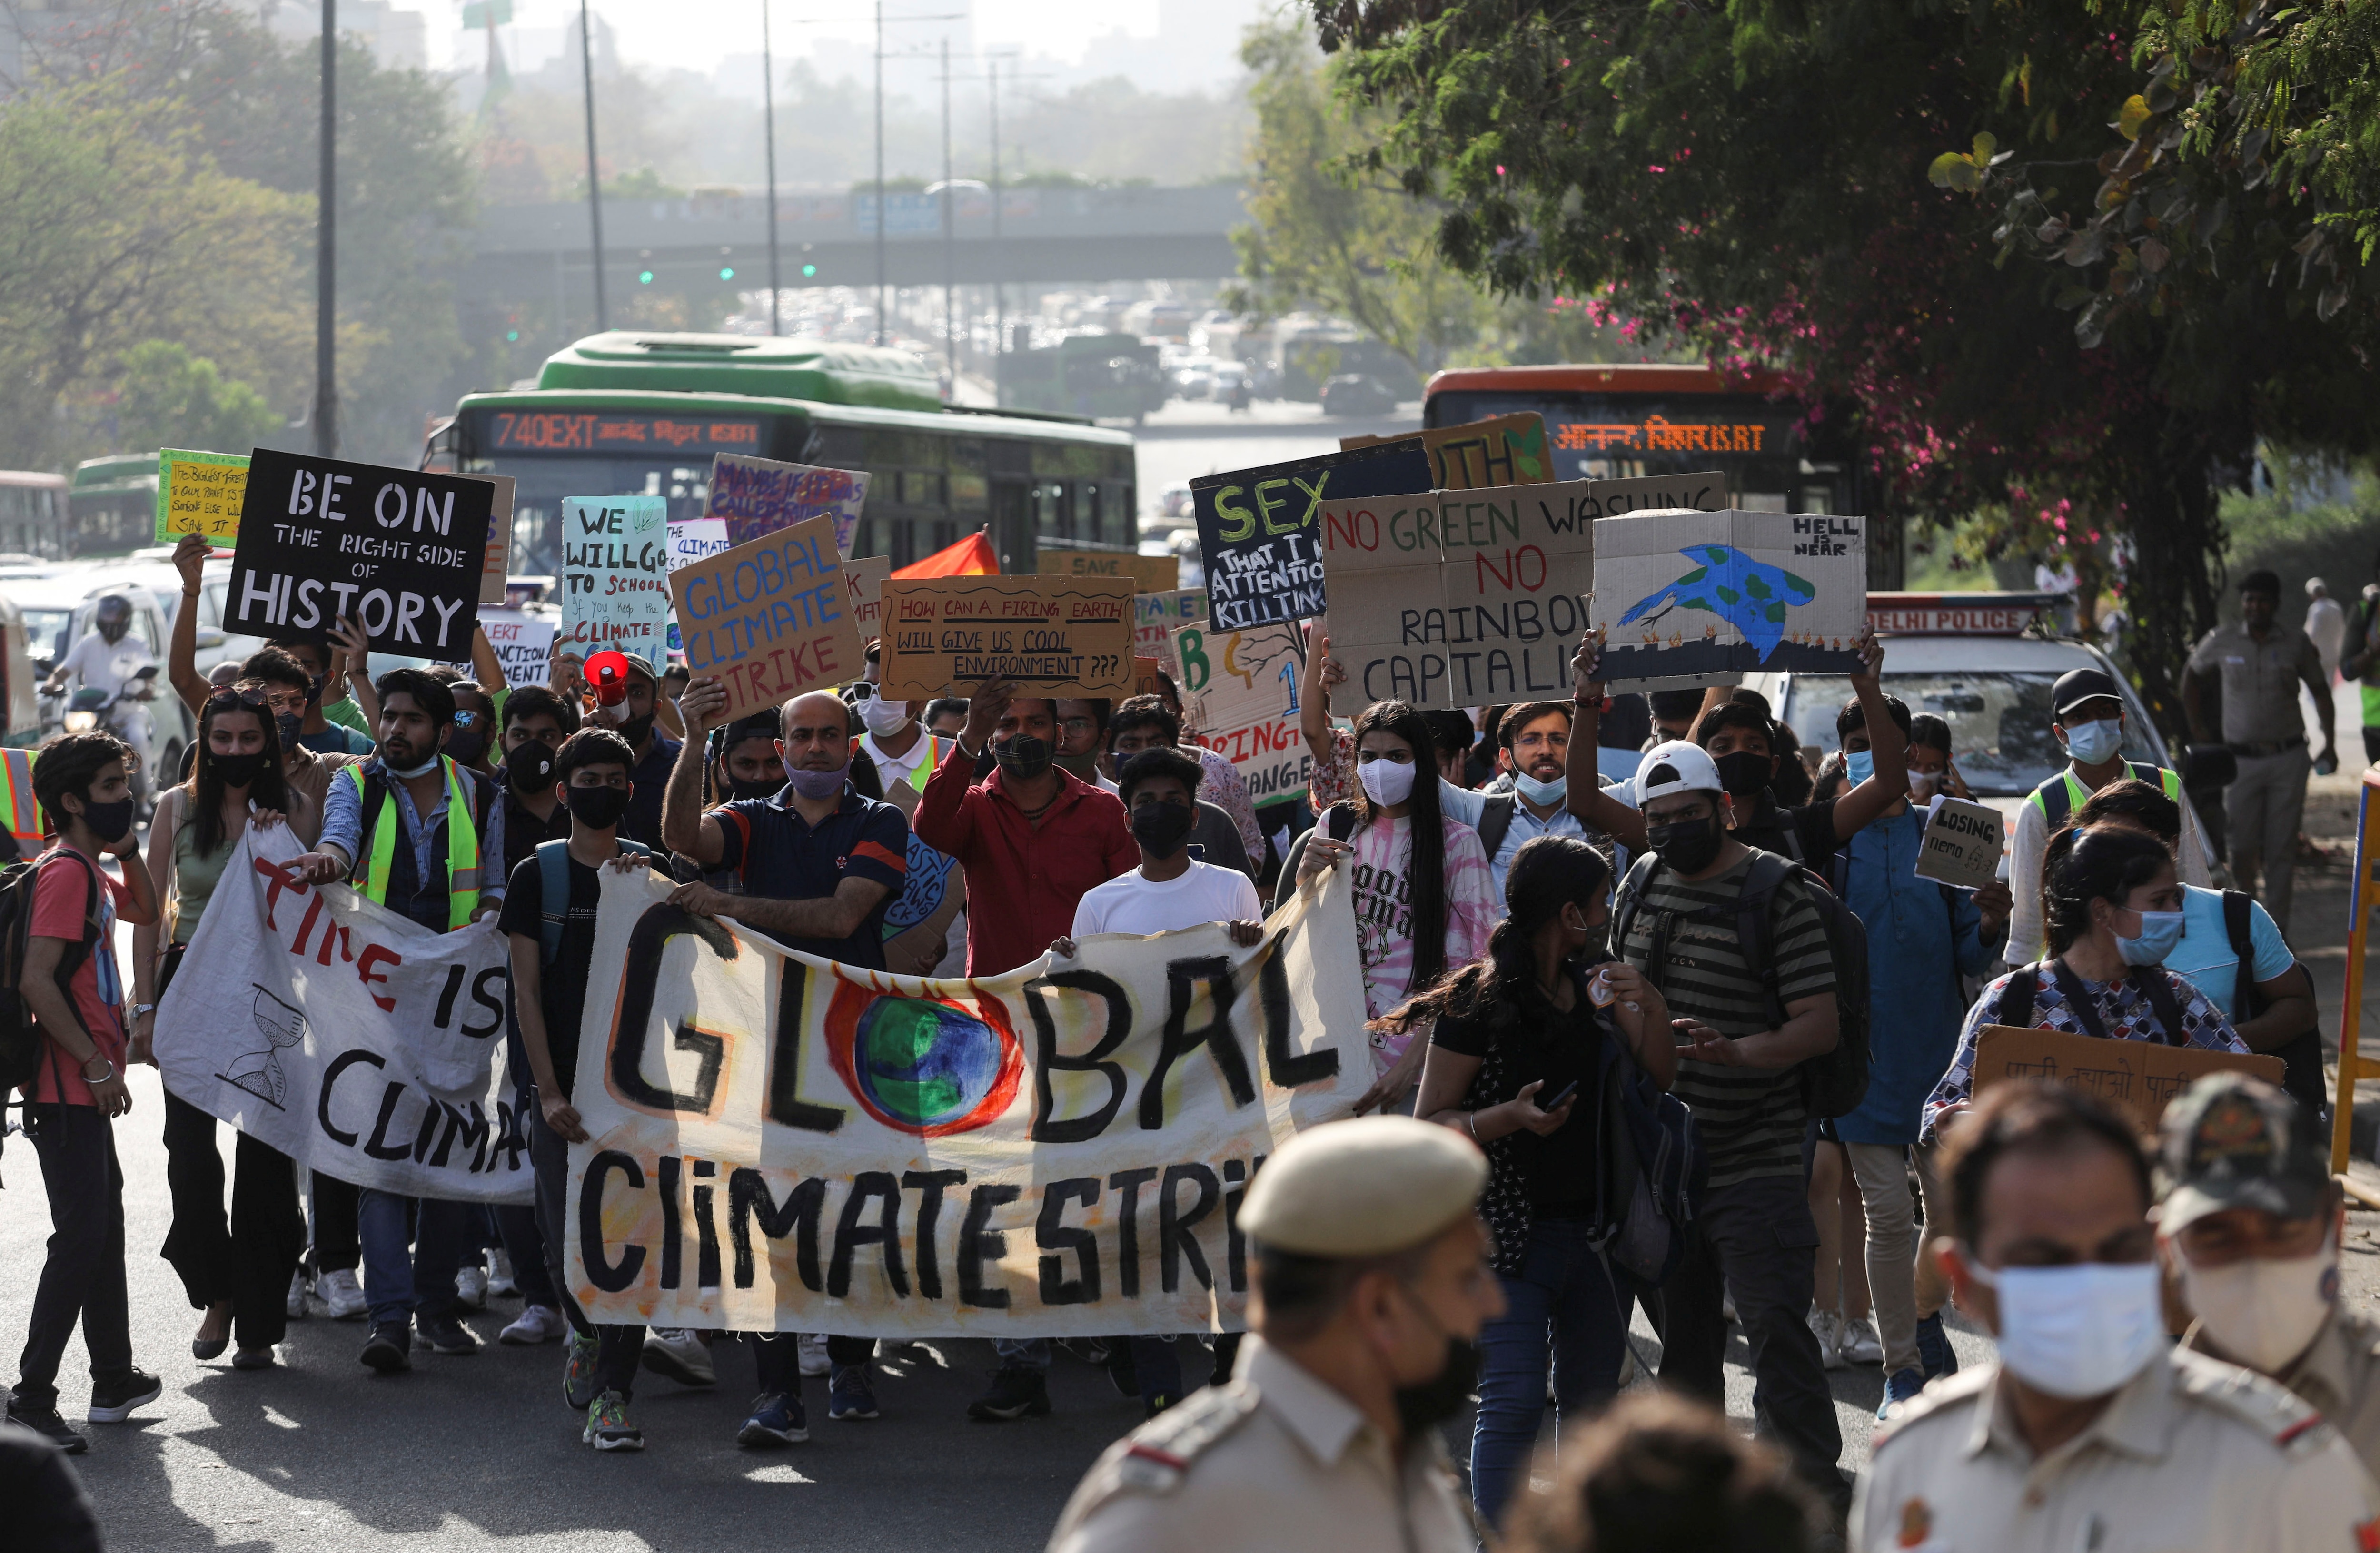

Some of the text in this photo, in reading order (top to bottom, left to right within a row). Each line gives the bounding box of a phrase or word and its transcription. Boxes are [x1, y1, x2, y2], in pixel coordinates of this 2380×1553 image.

[497, 413, 599, 449] 740EXT
[227, 489, 237, 500] IS
[714, 460, 783, 496] MAYBE
[830, 483, 863, 502] WAS
[205, 503, 222, 514] ELSE
[228, 504, 241, 516] WIL
[288, 469, 352, 521] BE
[375, 483, 455, 536] ON
[1214, 470, 1330, 542] SEX
[176, 517, 229, 533] SAVE IT
[579, 507, 625, 535] WE
[1326, 510, 1379, 552] NO
[1389, 499, 1521, 552] GREEN
[1793, 518, 1859, 535] HELL
[274, 524, 322, 548] THE
[340, 534, 411, 560] RIGHT
[416, 544, 466, 568] SIDE
[678, 539, 730, 556] CLIMATE
[1216, 543, 1275, 573] THAT
[1283, 533, 1309, 567] I
[1794, 543, 1847, 556] NEAR
[1813, 534, 1831, 544] IS
[352, 562, 379, 579] OF
[685, 536, 838, 619] GLOBAL
[1073, 557, 1119, 575] SAVE
[1212, 559, 1324, 600] ATTENTIO
[1476, 544, 1547, 594] NO
[567, 574, 664, 595] TO SCHOOL
[238, 569, 464, 647] HISTORY
[901, 599, 1122, 618] HOW CAN A FIRING EARTH
[1135, 596, 1208, 624] PLANET
[1937, 611, 2019, 630] POLICE
[484, 623, 523, 640] LERT
[575, 620, 651, 643] CLIMATE
[687, 581, 841, 670] CLIMATE
[897, 632, 934, 648] WILL
[942, 631, 983, 650] GIVE
[993, 631, 1012, 650] US
[1024, 630, 1071, 651] COOL
[1135, 624, 1167, 643] RTH
[493, 644, 546, 662] NCTION
[954, 655, 1119, 677] ENVIRONMENT ???
[712, 636, 838, 719] STRIKE
[1364, 644, 1575, 704] CAPTALI
[1243, 755, 1311, 797] ANGE
[1936, 809, 1995, 844] LOSING
[1352, 889, 1414, 941] rma
[1645, 952, 1696, 967] LDON
[433, 964, 506, 1039] IS
[608, 901, 1340, 1142] GLOBAL
[318, 1049, 535, 1174] CLIMA
[1036, 1154, 1267, 1305] STRi
